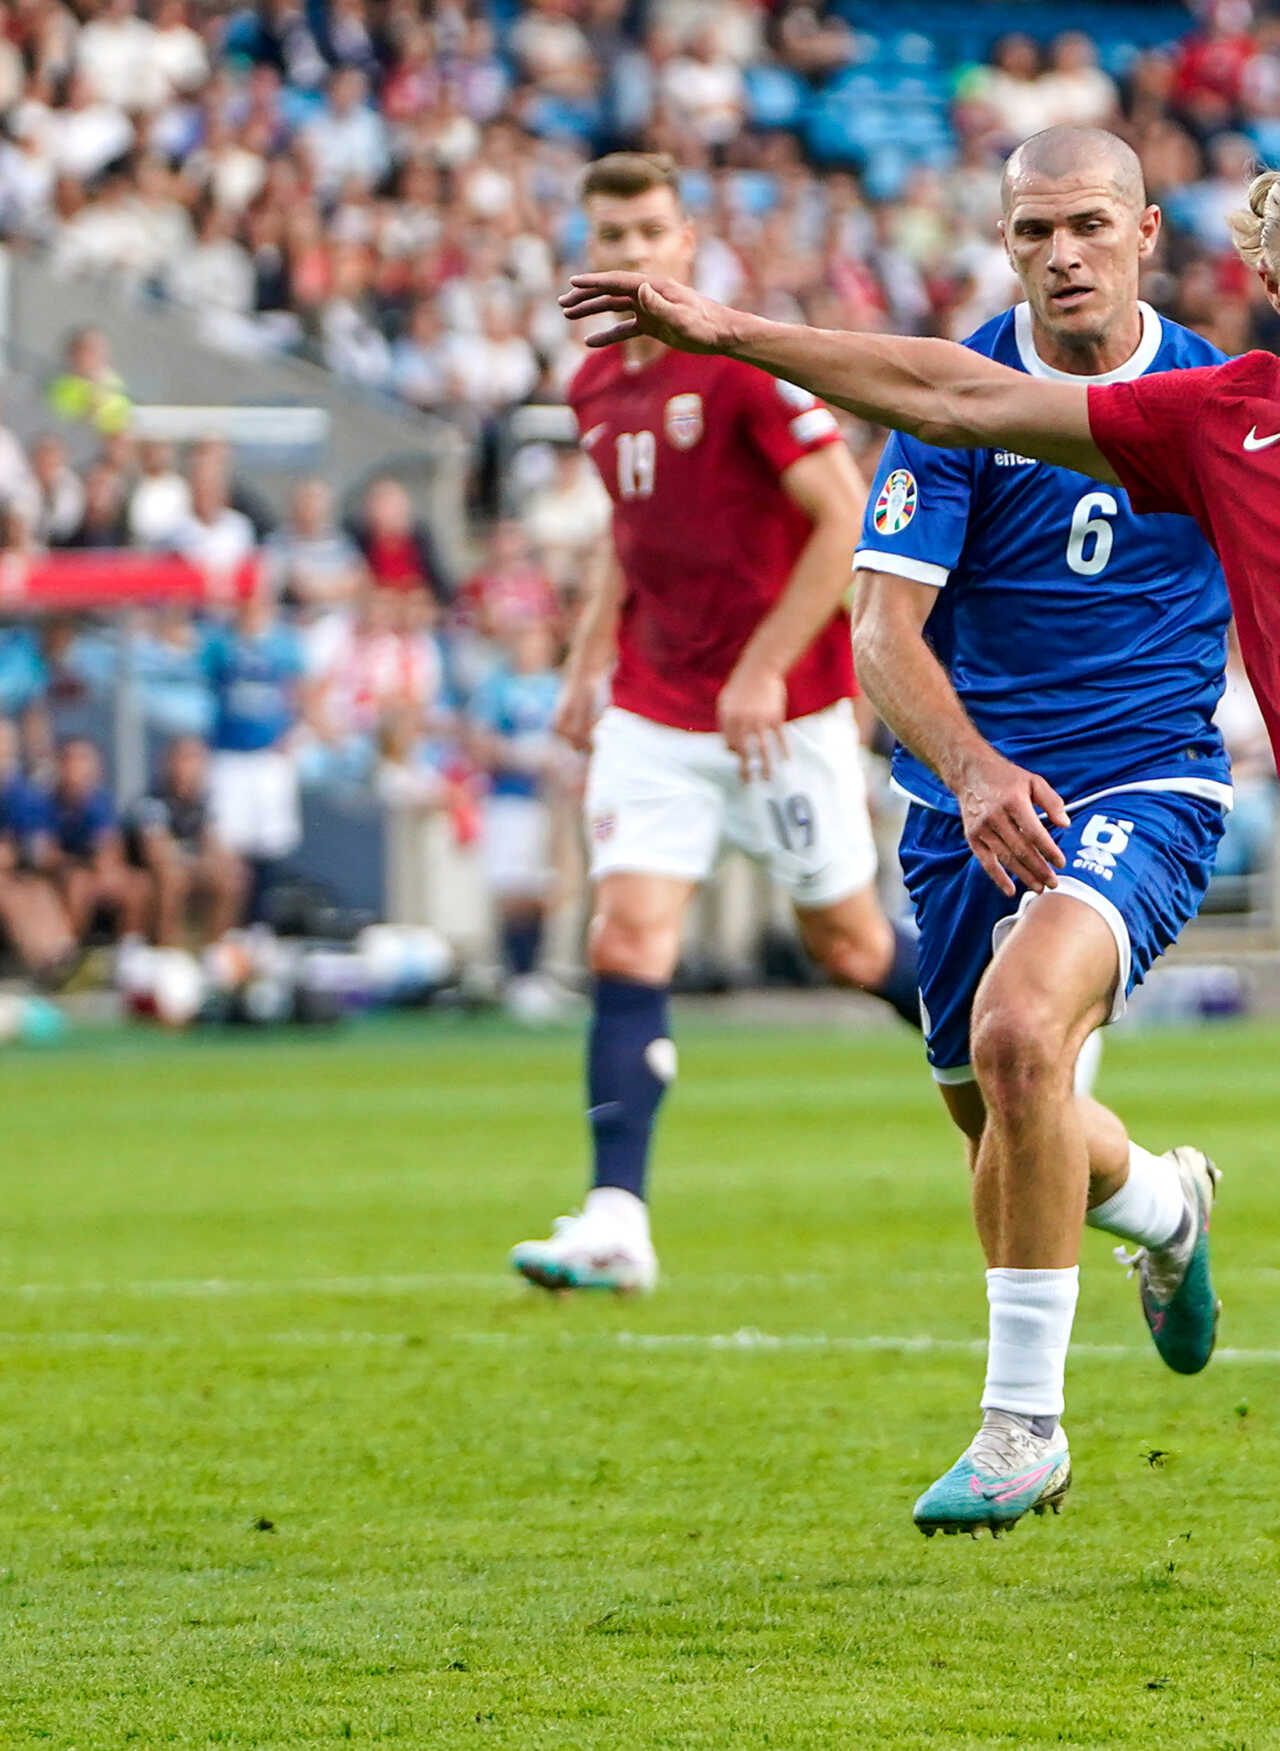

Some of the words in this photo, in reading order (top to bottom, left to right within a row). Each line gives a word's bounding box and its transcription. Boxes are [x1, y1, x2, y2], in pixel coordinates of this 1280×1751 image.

[616, 429, 656, 500] 19
[1066, 491, 1118, 576] 6
[767, 792, 816, 850] 19
[1080, 813, 1135, 855] 6
